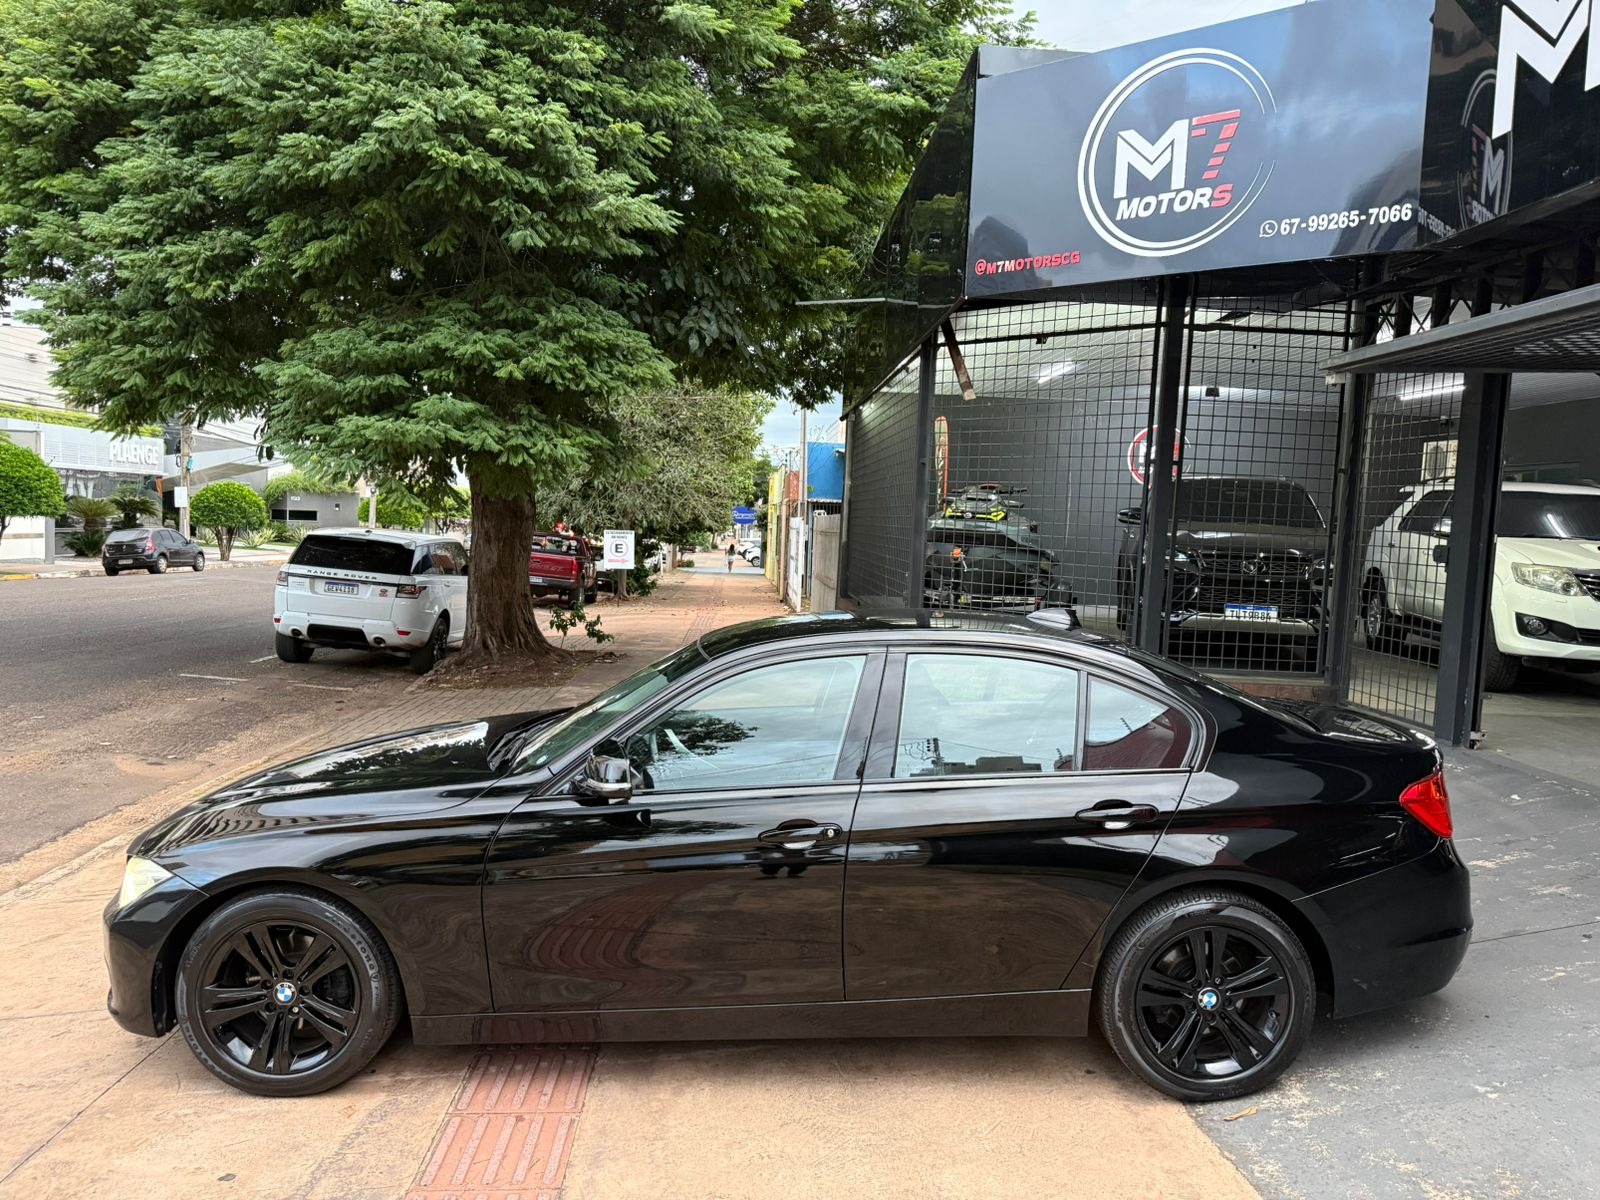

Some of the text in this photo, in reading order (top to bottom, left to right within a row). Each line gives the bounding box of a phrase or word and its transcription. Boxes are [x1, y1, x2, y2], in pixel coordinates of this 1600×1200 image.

[1113, 109, 1241, 199] M7
[1115, 184, 1233, 220] MOTORS
[1280, 203, 1413, 235] 67-99265-7066
[975, 250, 1081, 275] @M7MOTORSCG
[110, 443, 159, 465] PLAENGE
[615, 543, 624, 553] E
